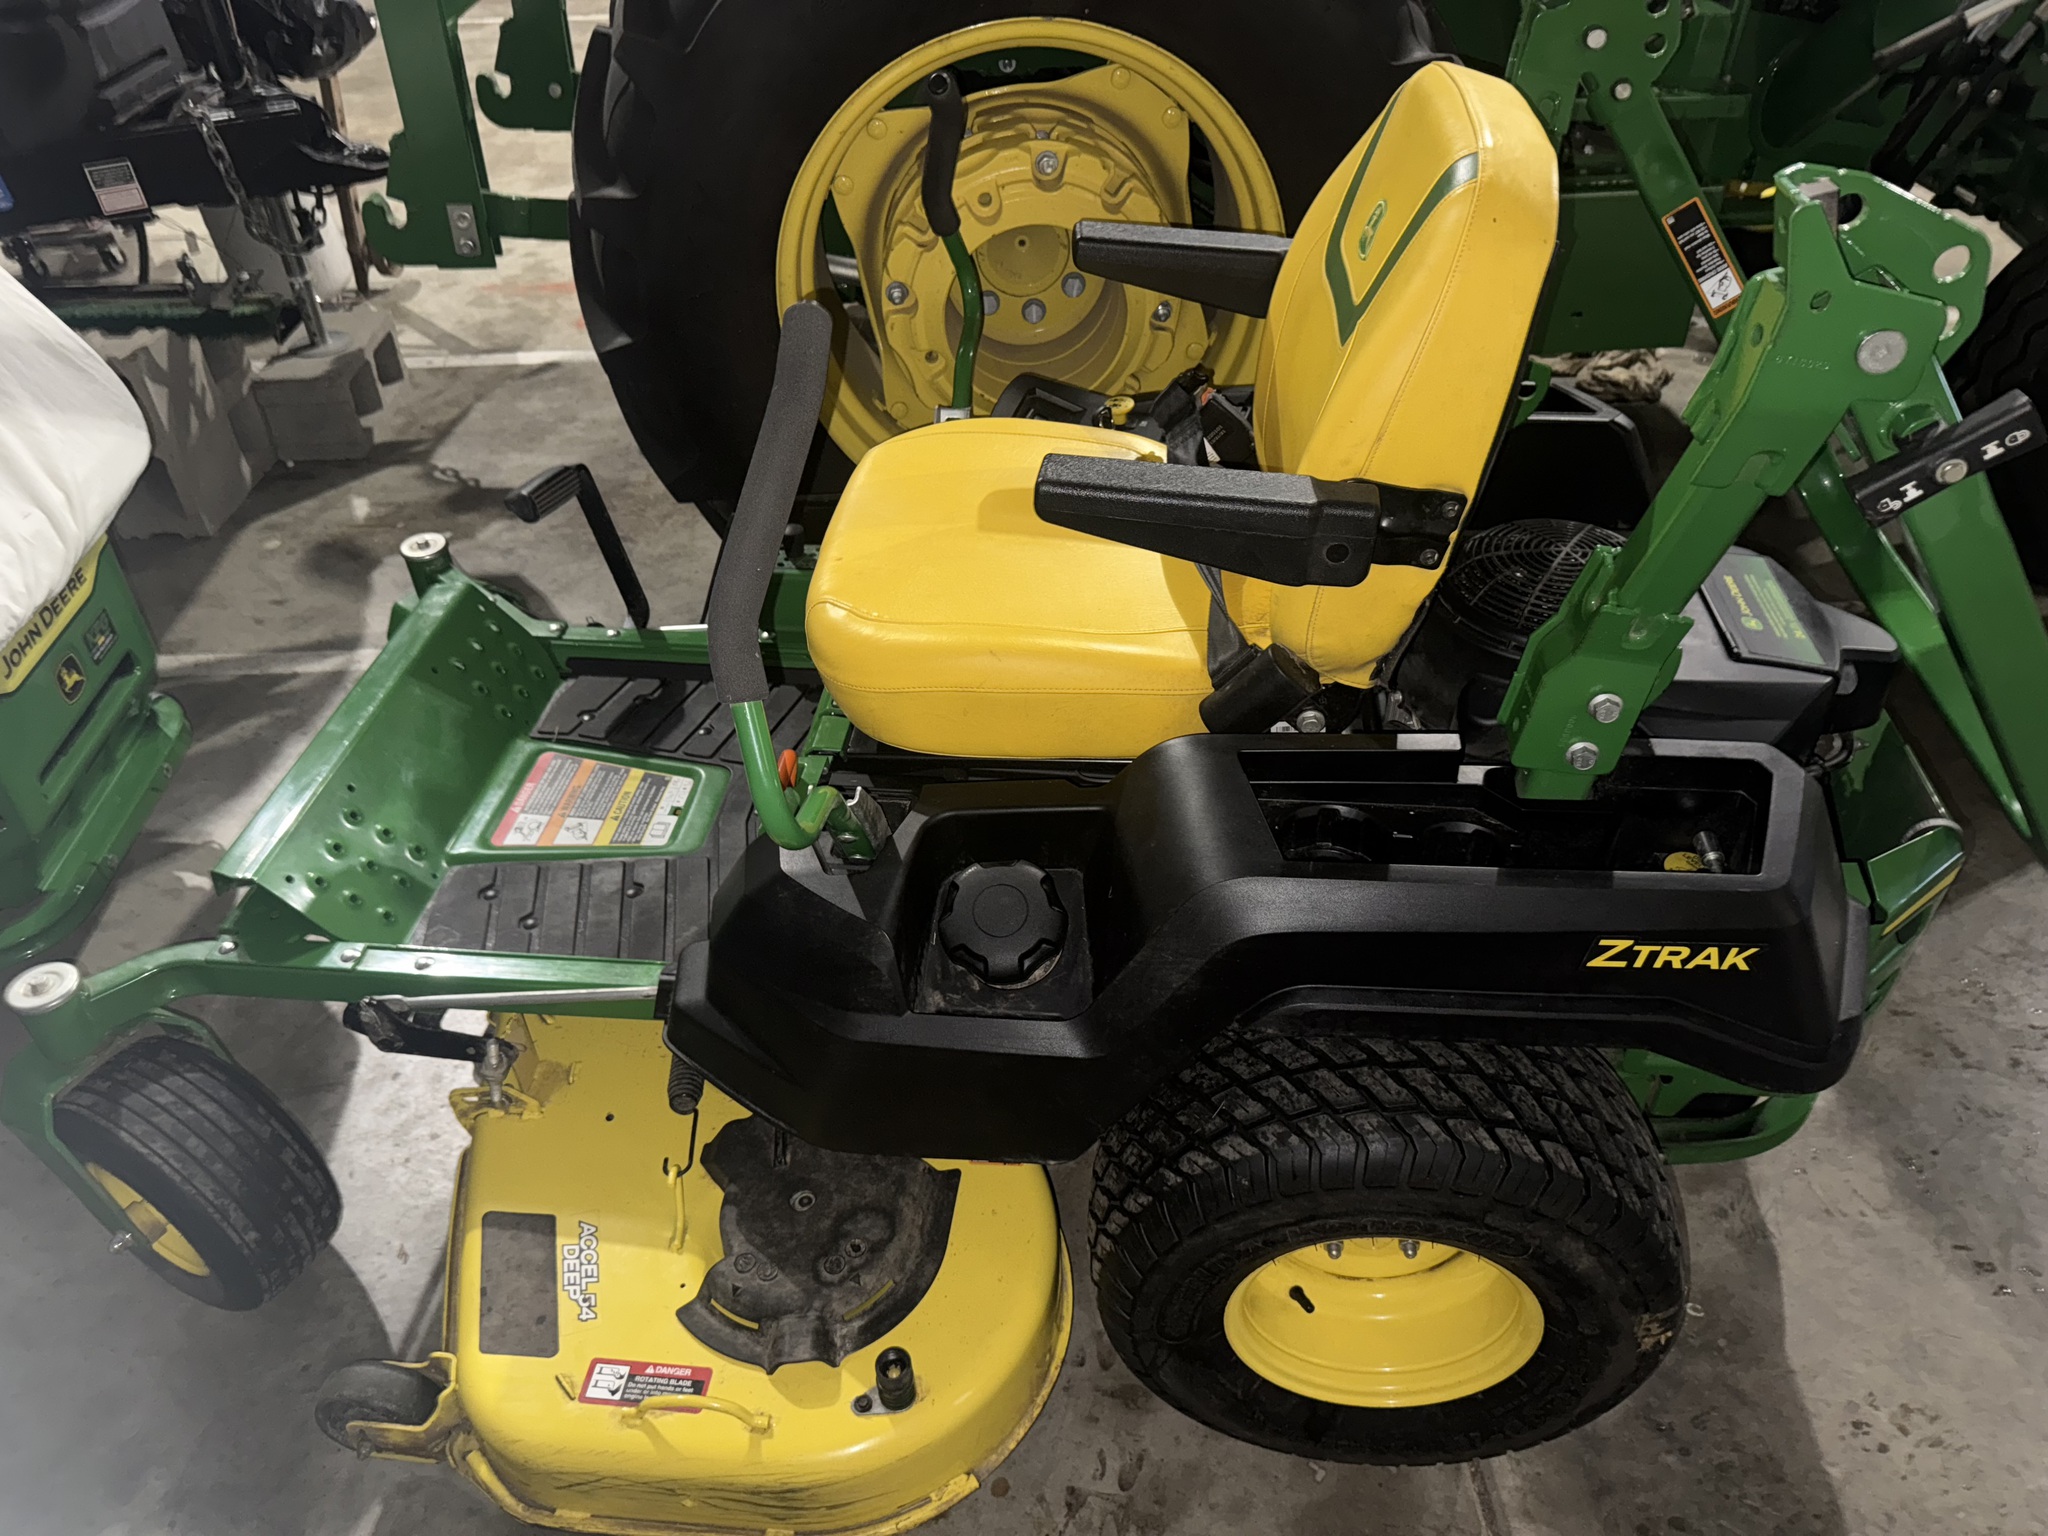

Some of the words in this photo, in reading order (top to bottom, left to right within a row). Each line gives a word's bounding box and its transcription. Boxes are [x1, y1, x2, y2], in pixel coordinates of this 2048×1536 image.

[4, 624, 43, 680] JOHN
[40, 567, 87, 629] DEERE
[615, 791, 632, 815] CAUTION
[1585, 939, 1761, 971] ZTRAK
[578, 1220, 599, 1291] ACCEL
[562, 1244, 581, 1303] DEEP
[578, 1292, 597, 1321] 54
[634, 1375, 669, 1384] ROTATING
[668, 1378, 693, 1386] BLADE
[655, 1366, 692, 1376] DANGER
